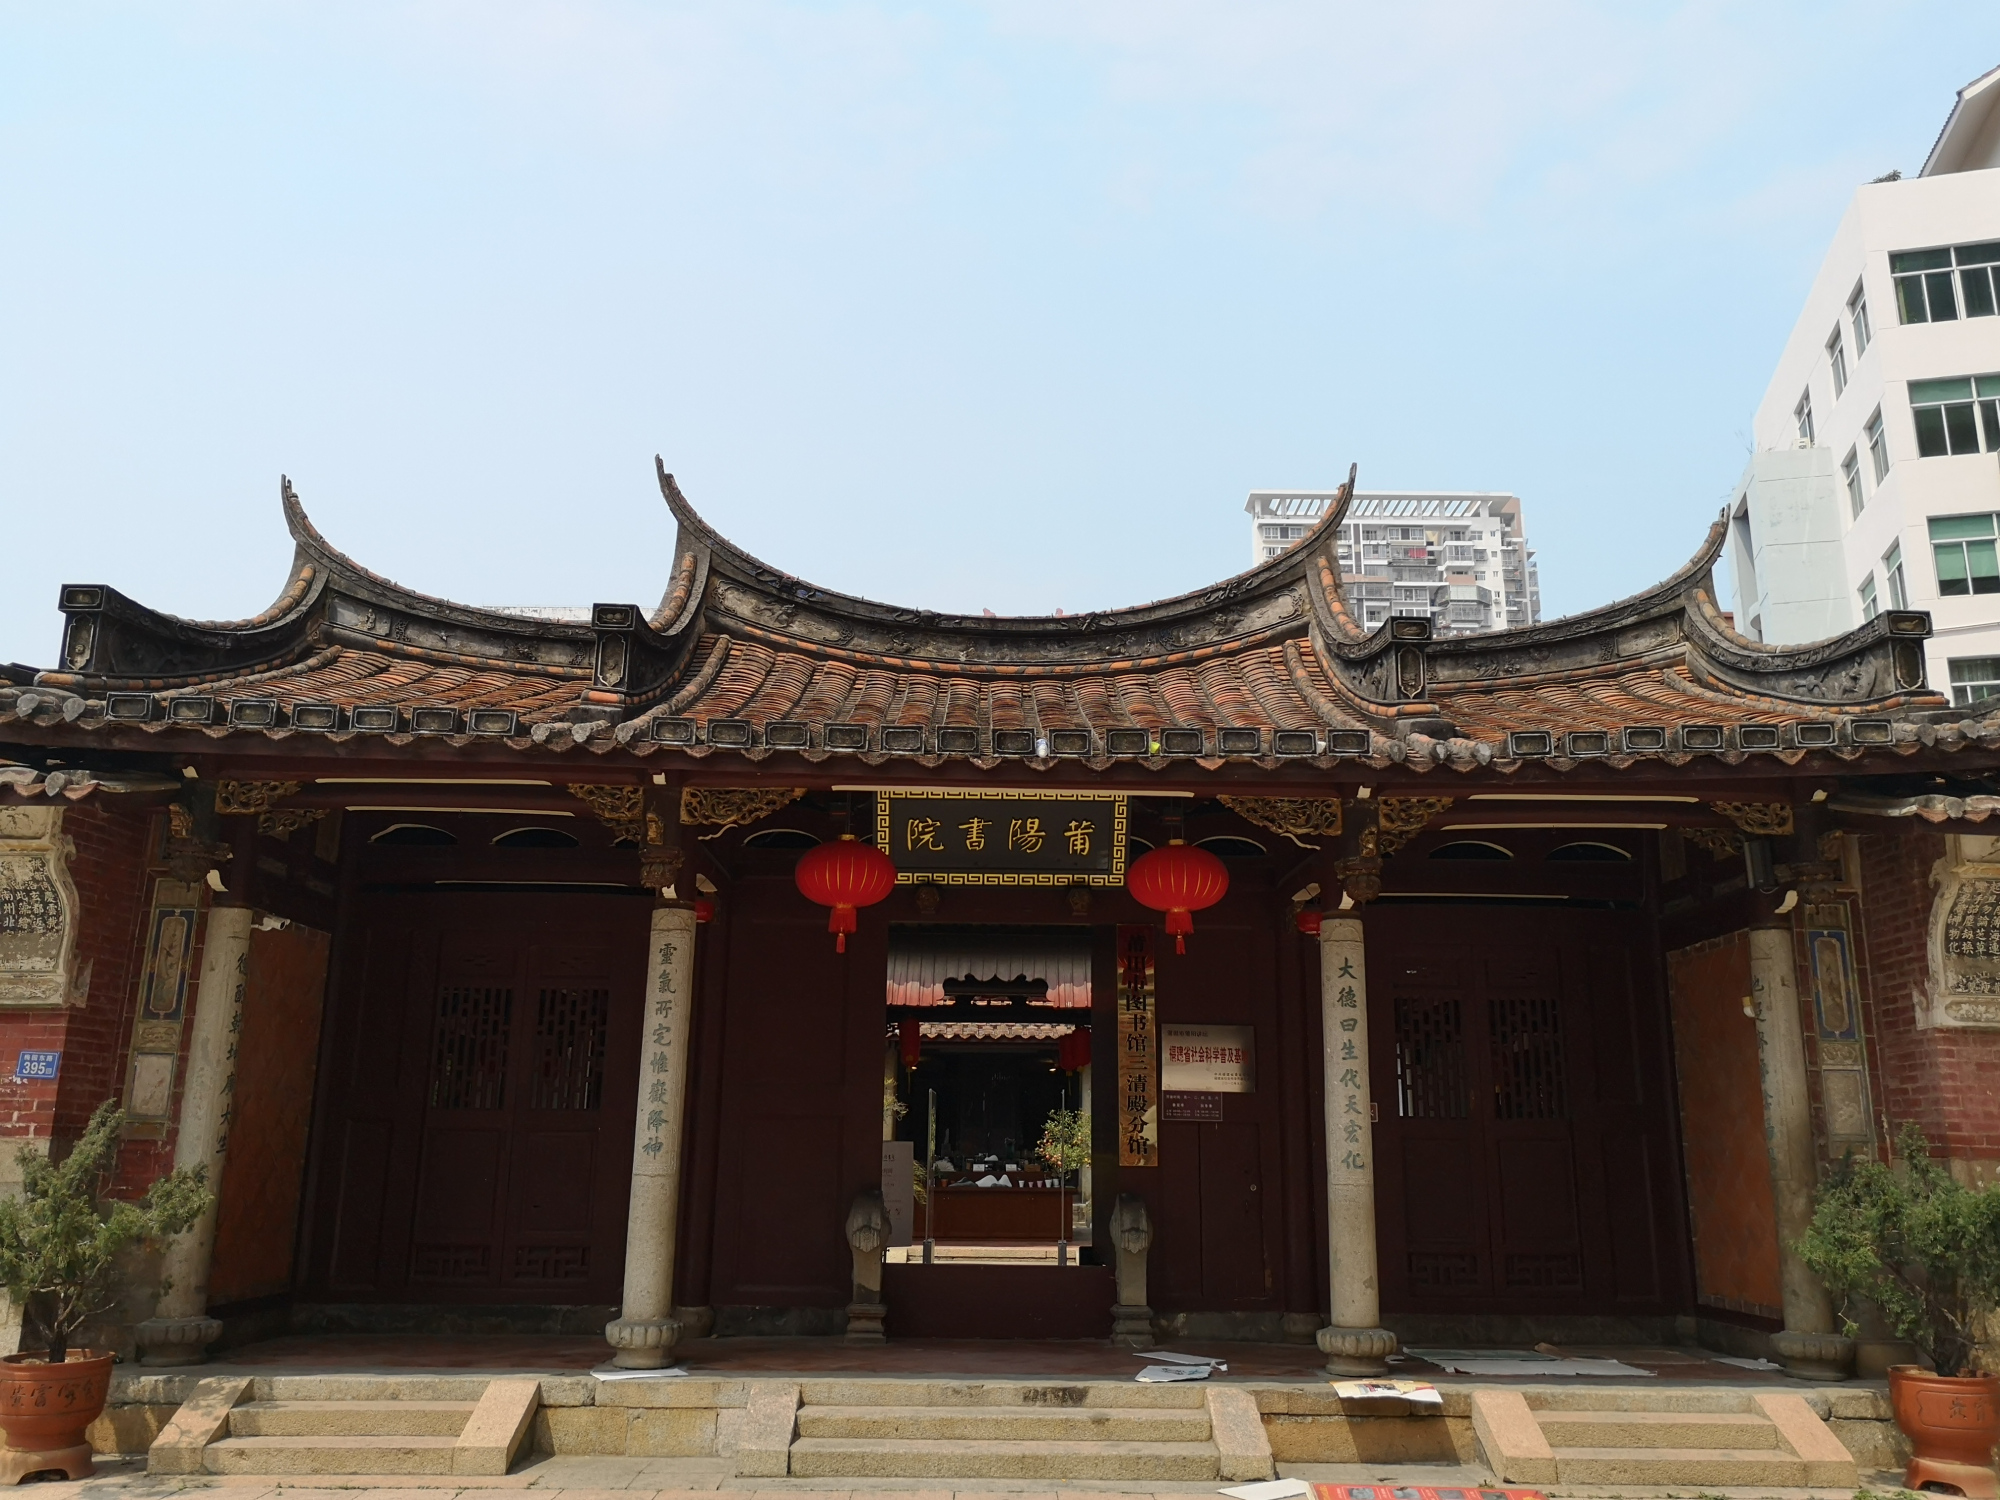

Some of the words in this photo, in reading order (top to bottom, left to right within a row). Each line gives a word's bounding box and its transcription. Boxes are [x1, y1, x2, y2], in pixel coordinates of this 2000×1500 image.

[906, 816, 1096, 856] 莆陽書院
[22, 1061, 46, 1075] 395
